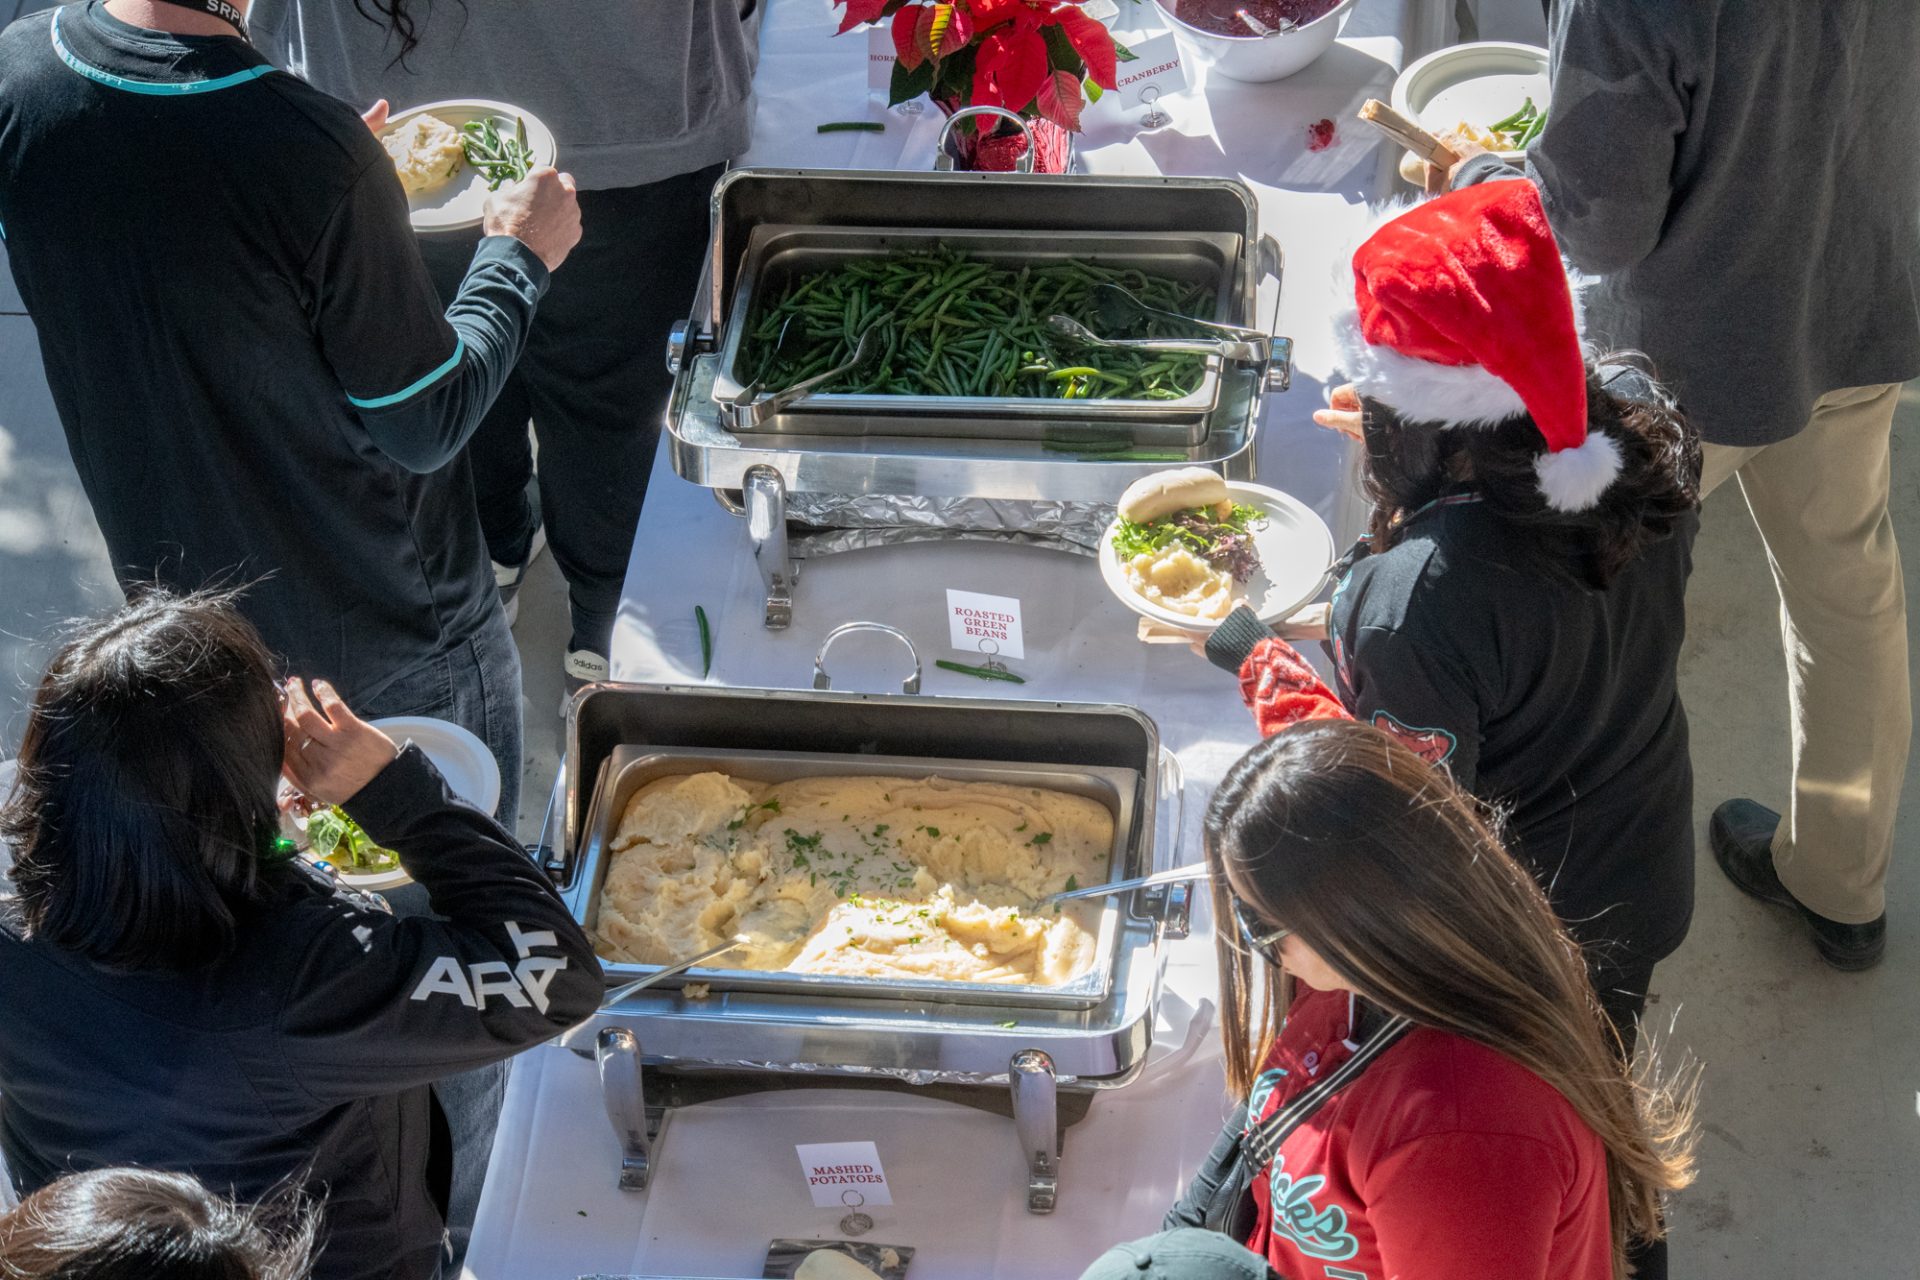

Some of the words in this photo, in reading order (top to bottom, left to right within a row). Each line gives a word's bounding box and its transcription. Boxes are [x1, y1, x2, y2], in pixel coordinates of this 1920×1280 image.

[1117, 60, 1179, 88] CRANBERRY
[955, 607, 1015, 623] ROASTED
[964, 617, 1007, 631] GREEN
[965, 626, 1008, 641] BEANS
[573, 658, 603, 671] adidas
[813, 1164, 874, 1175] MASHED
[809, 1174, 884, 1186] POTATOES
